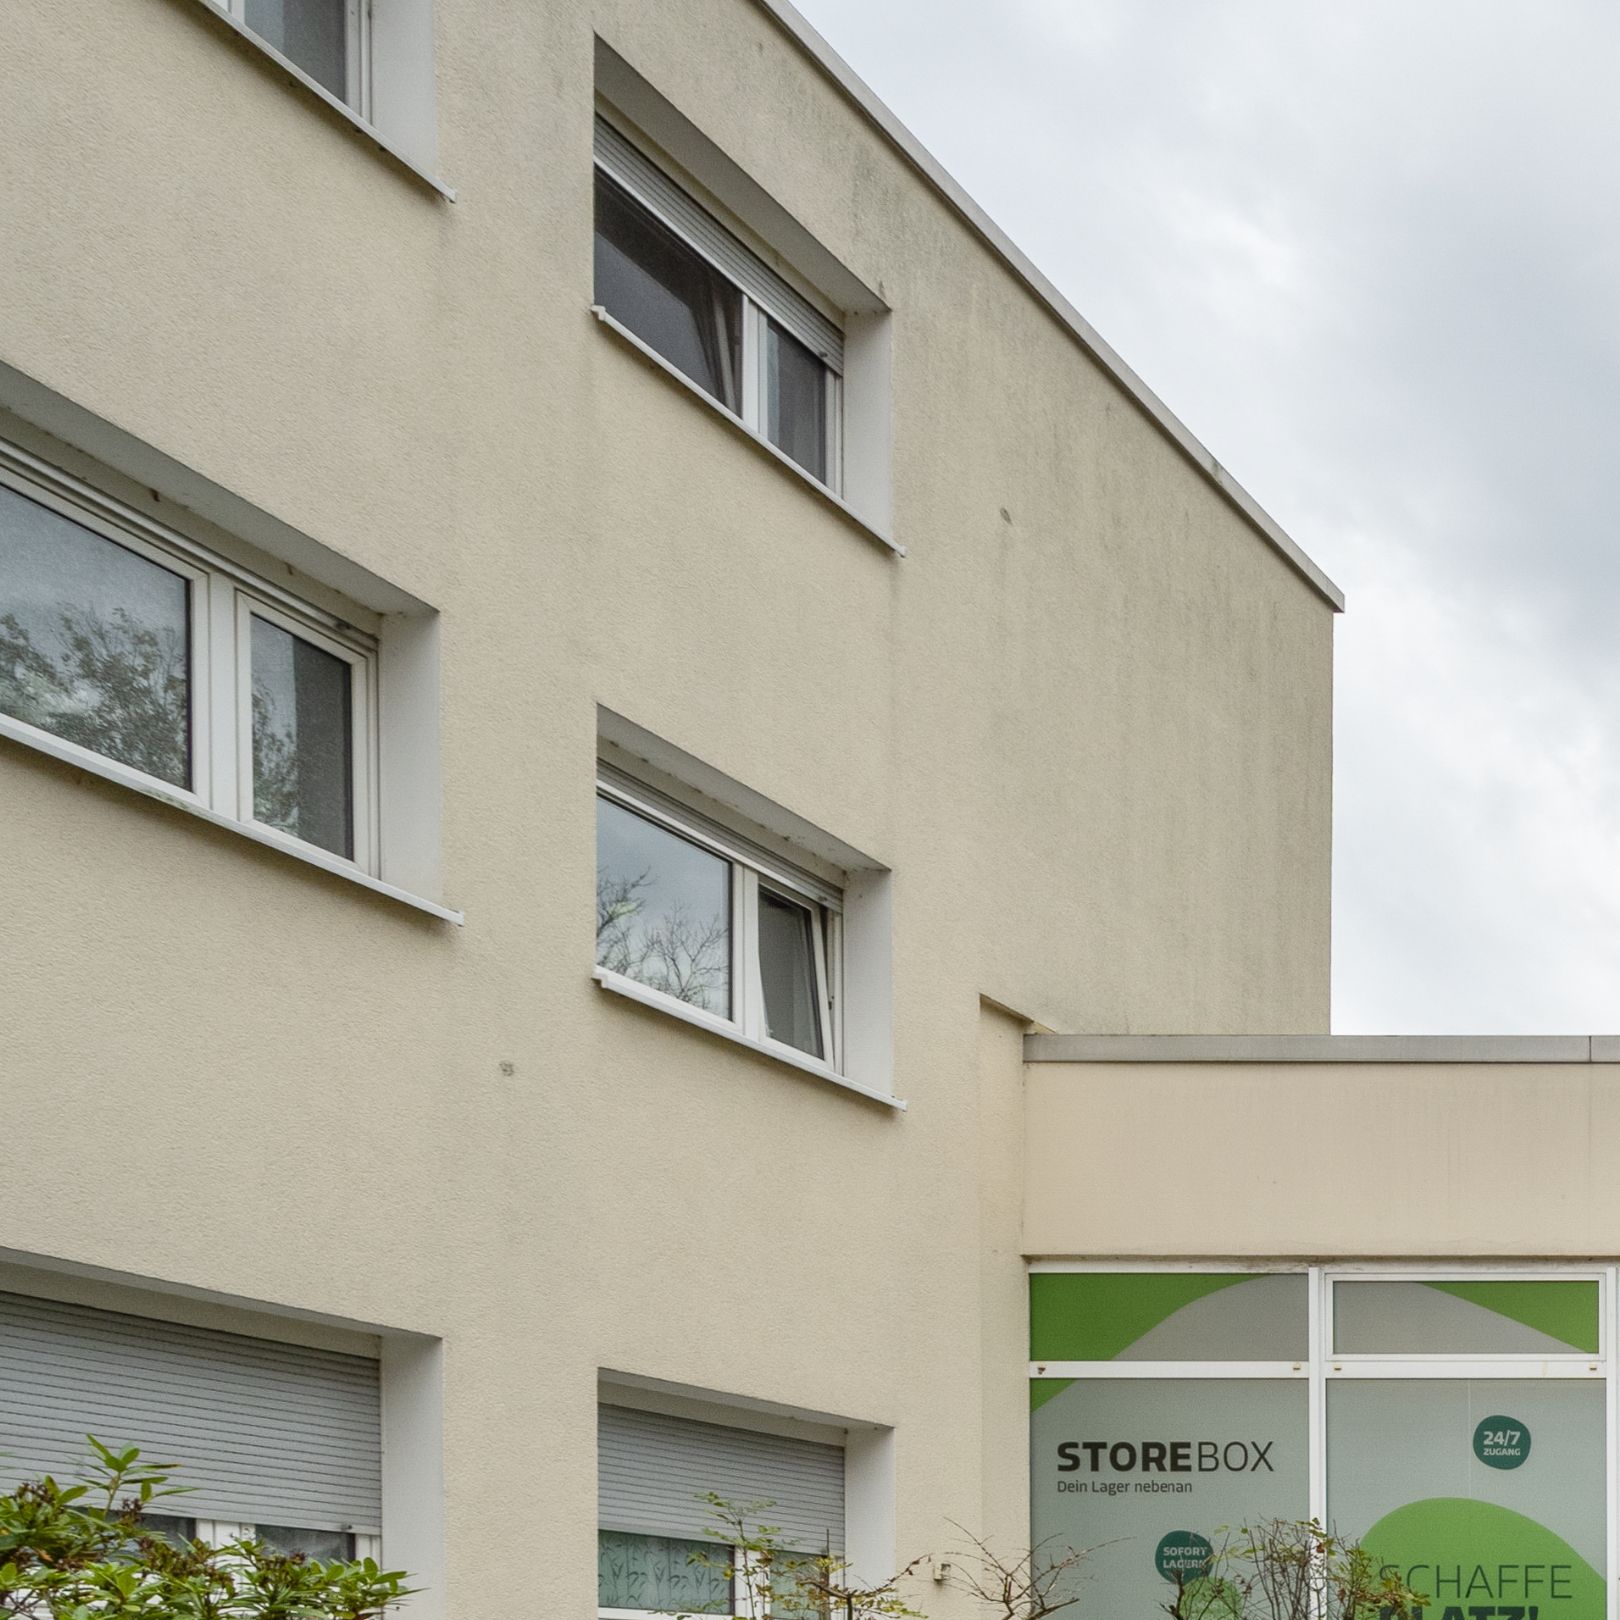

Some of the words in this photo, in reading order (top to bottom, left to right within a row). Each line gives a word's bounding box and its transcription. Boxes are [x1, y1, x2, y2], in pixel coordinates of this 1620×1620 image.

[1483, 1430, 1521, 1446] 24/7
[1057, 1441, 1275, 1472] STOREBOX
[1483, 1448, 1521, 1456] ZUGANG
[1057, 1480, 1088, 1493] Dein
[1092, 1480, 1130, 1496] Lager
[1134, 1480, 1192, 1493] nebenan
[1163, 1546, 1208, 1556] SOFORT
